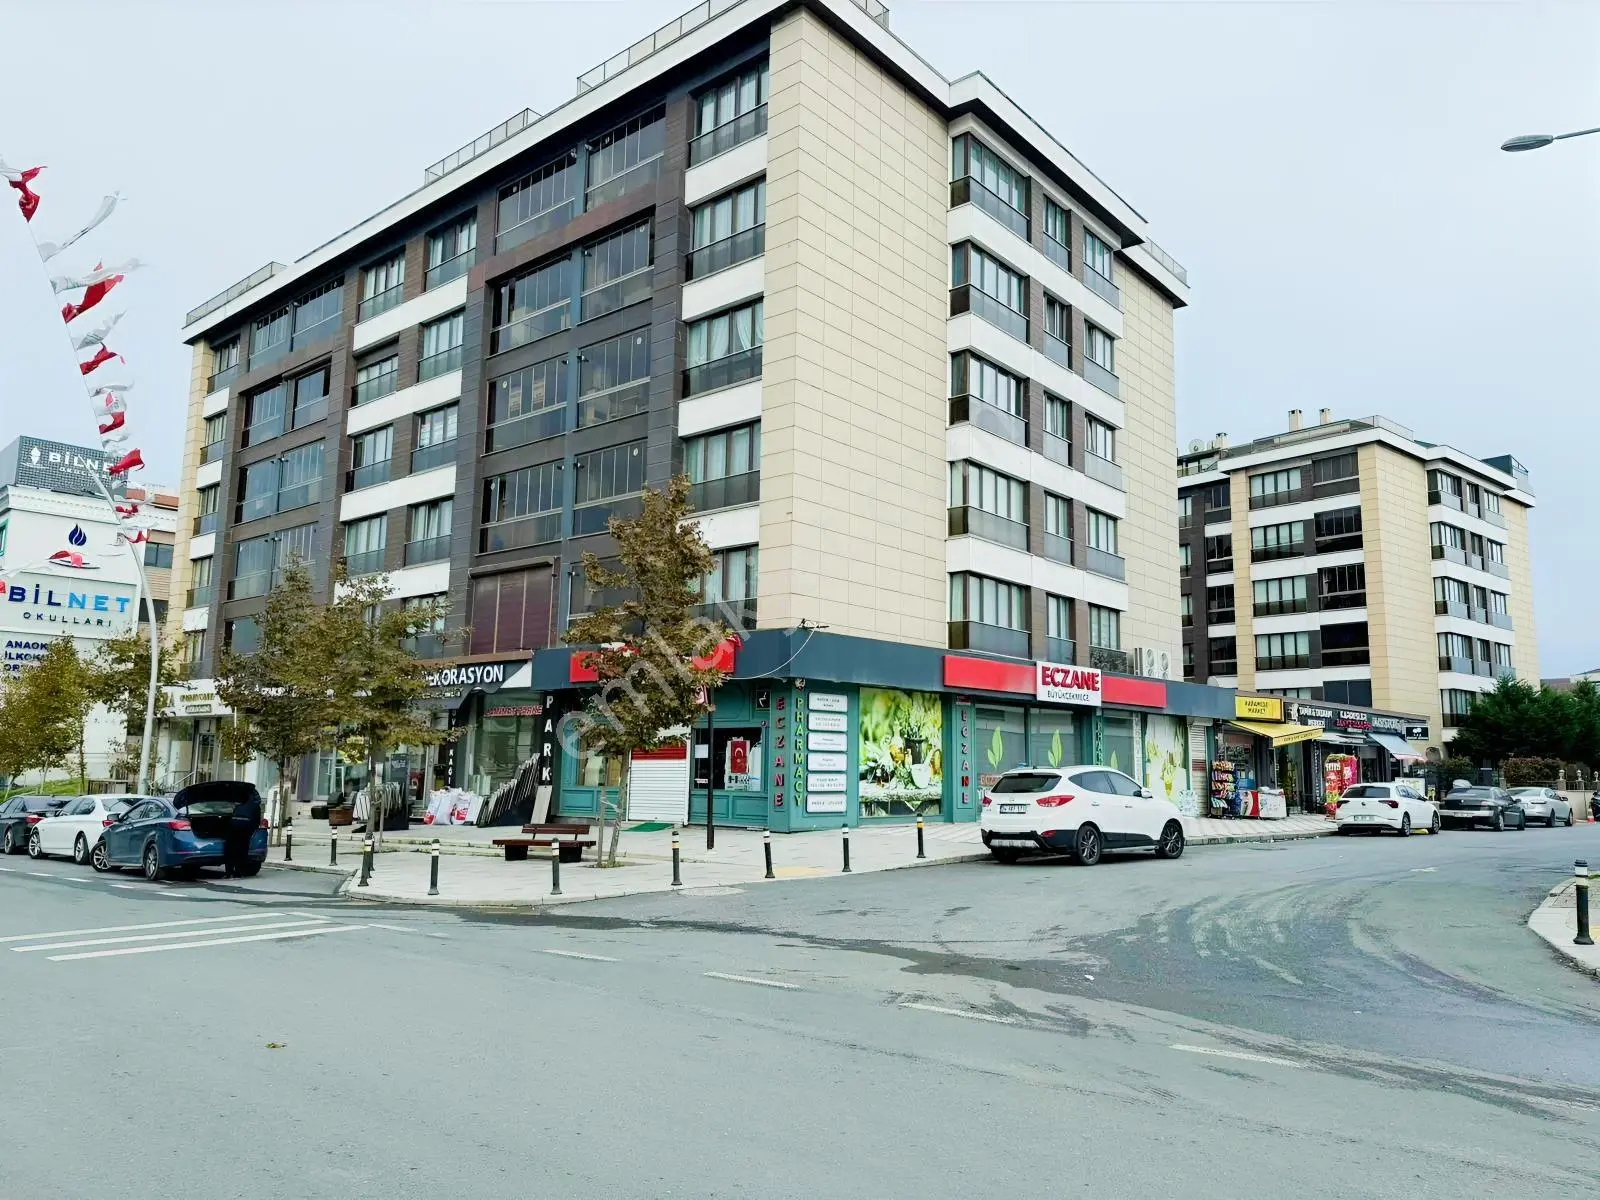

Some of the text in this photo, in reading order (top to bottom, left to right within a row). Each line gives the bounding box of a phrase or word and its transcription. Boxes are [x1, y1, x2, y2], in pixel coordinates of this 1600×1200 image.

[48, 451, 114, 473] BİLNE
[8, 584, 130, 613] BİLNET
[23, 612, 111, 627] OKULLARI
[5, 640, 49, 650] ANAOK
[1041, 666, 1100, 691] ECZANE
[542, 696, 553, 781] PARK
[774, 697, 785, 807] ECZANE
[794, 697, 804, 807] PHARMACY
[961, 709, 970, 804] ECZANE
